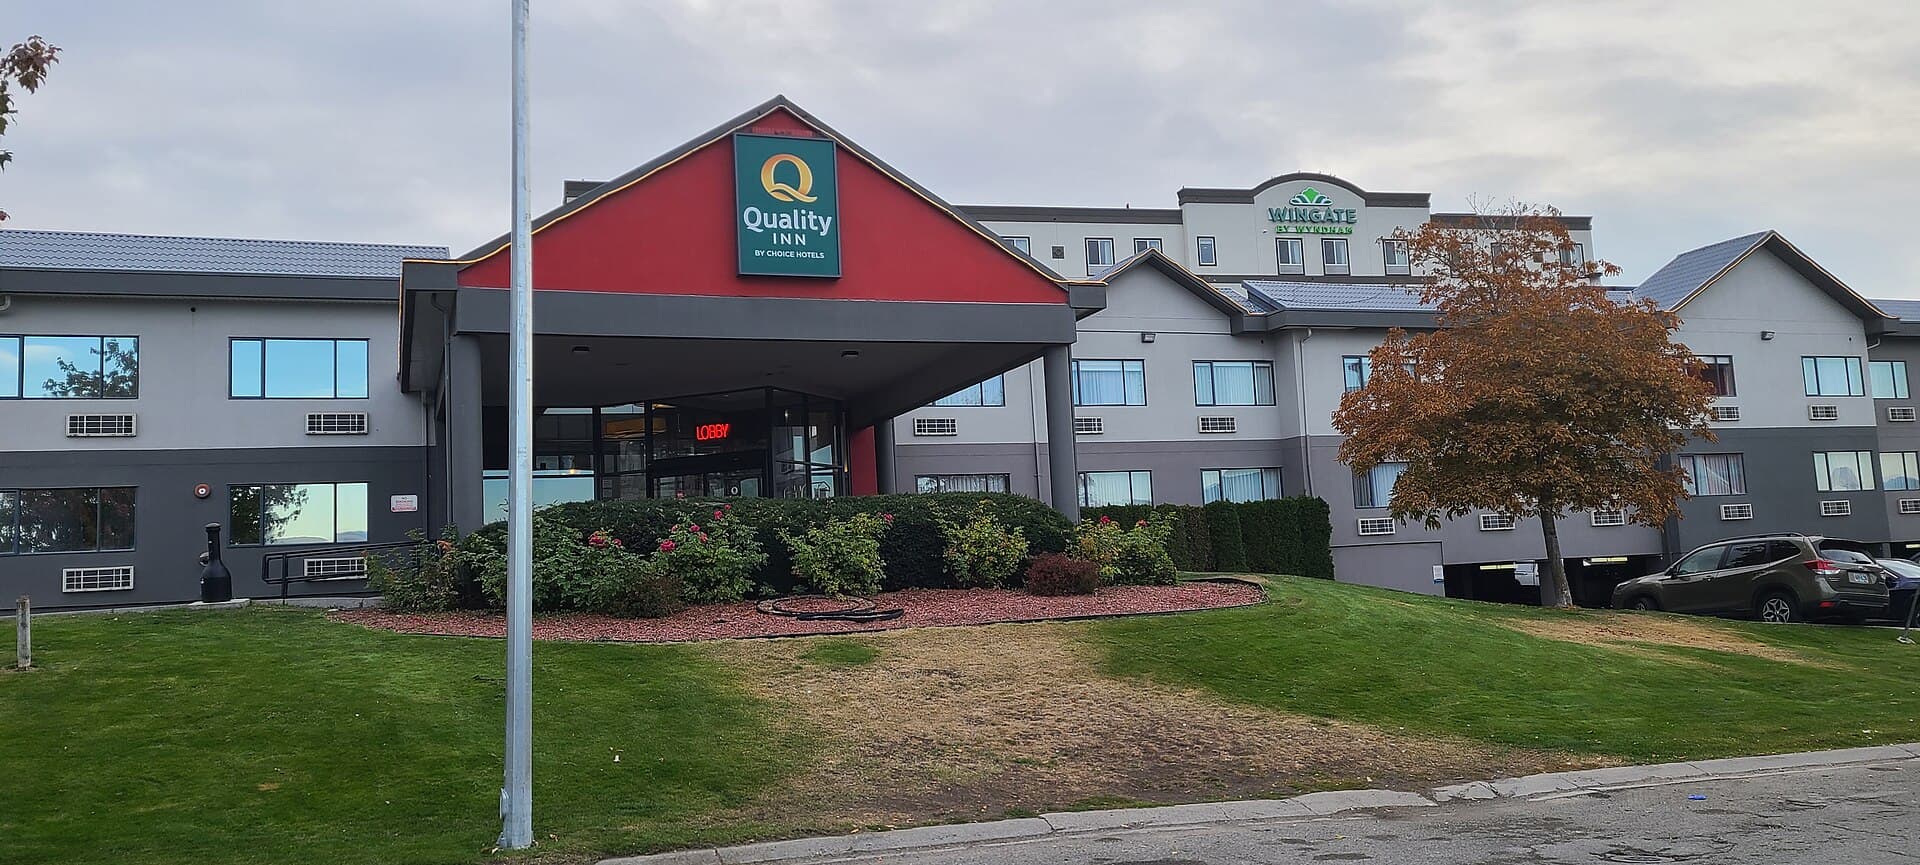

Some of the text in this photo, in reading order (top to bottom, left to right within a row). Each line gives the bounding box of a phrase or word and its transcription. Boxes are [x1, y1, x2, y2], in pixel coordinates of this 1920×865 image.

[760, 153, 818, 203] Q
[743, 206, 832, 236] Quality
[1268, 207, 1357, 224] WINGATE
[1276, 225, 1353, 235] BY WYNDHAM
[772, 232, 806, 246] INN
[754, 249, 825, 259] BY CHOICE HOTELS
[696, 423, 729, 440] LOBBY
